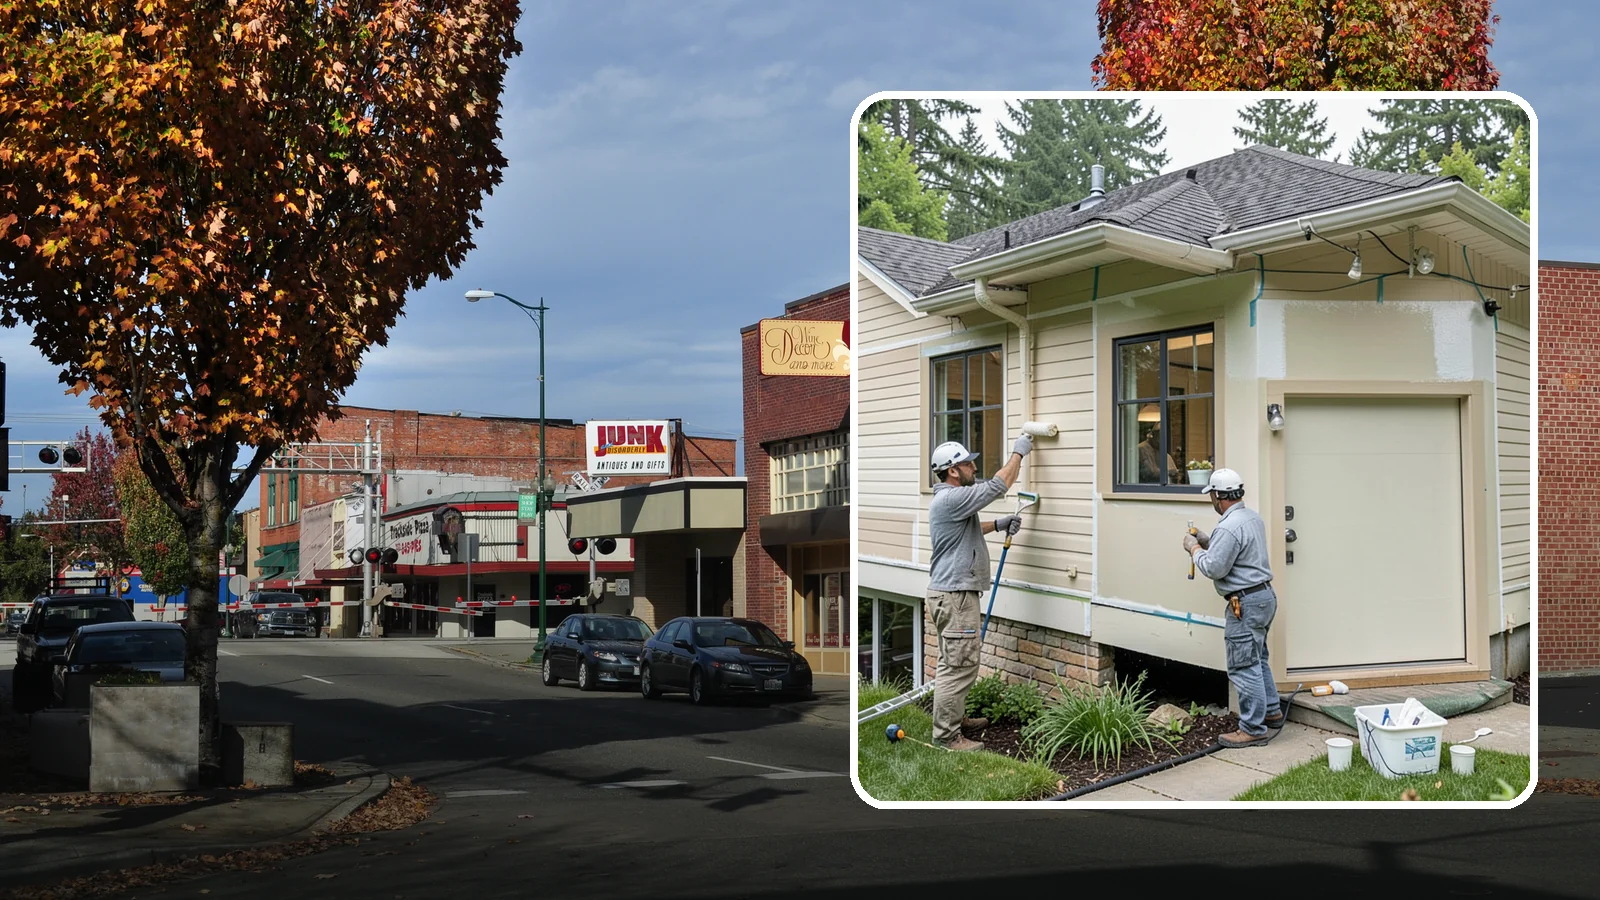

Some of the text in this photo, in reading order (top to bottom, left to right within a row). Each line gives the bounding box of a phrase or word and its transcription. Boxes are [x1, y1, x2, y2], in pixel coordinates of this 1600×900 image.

[596, 425, 664, 457] JUNK
[597, 460, 665, 470] ANTIQUES AND GIFTS
[390, 519, 429, 539] Trackside Pizza
